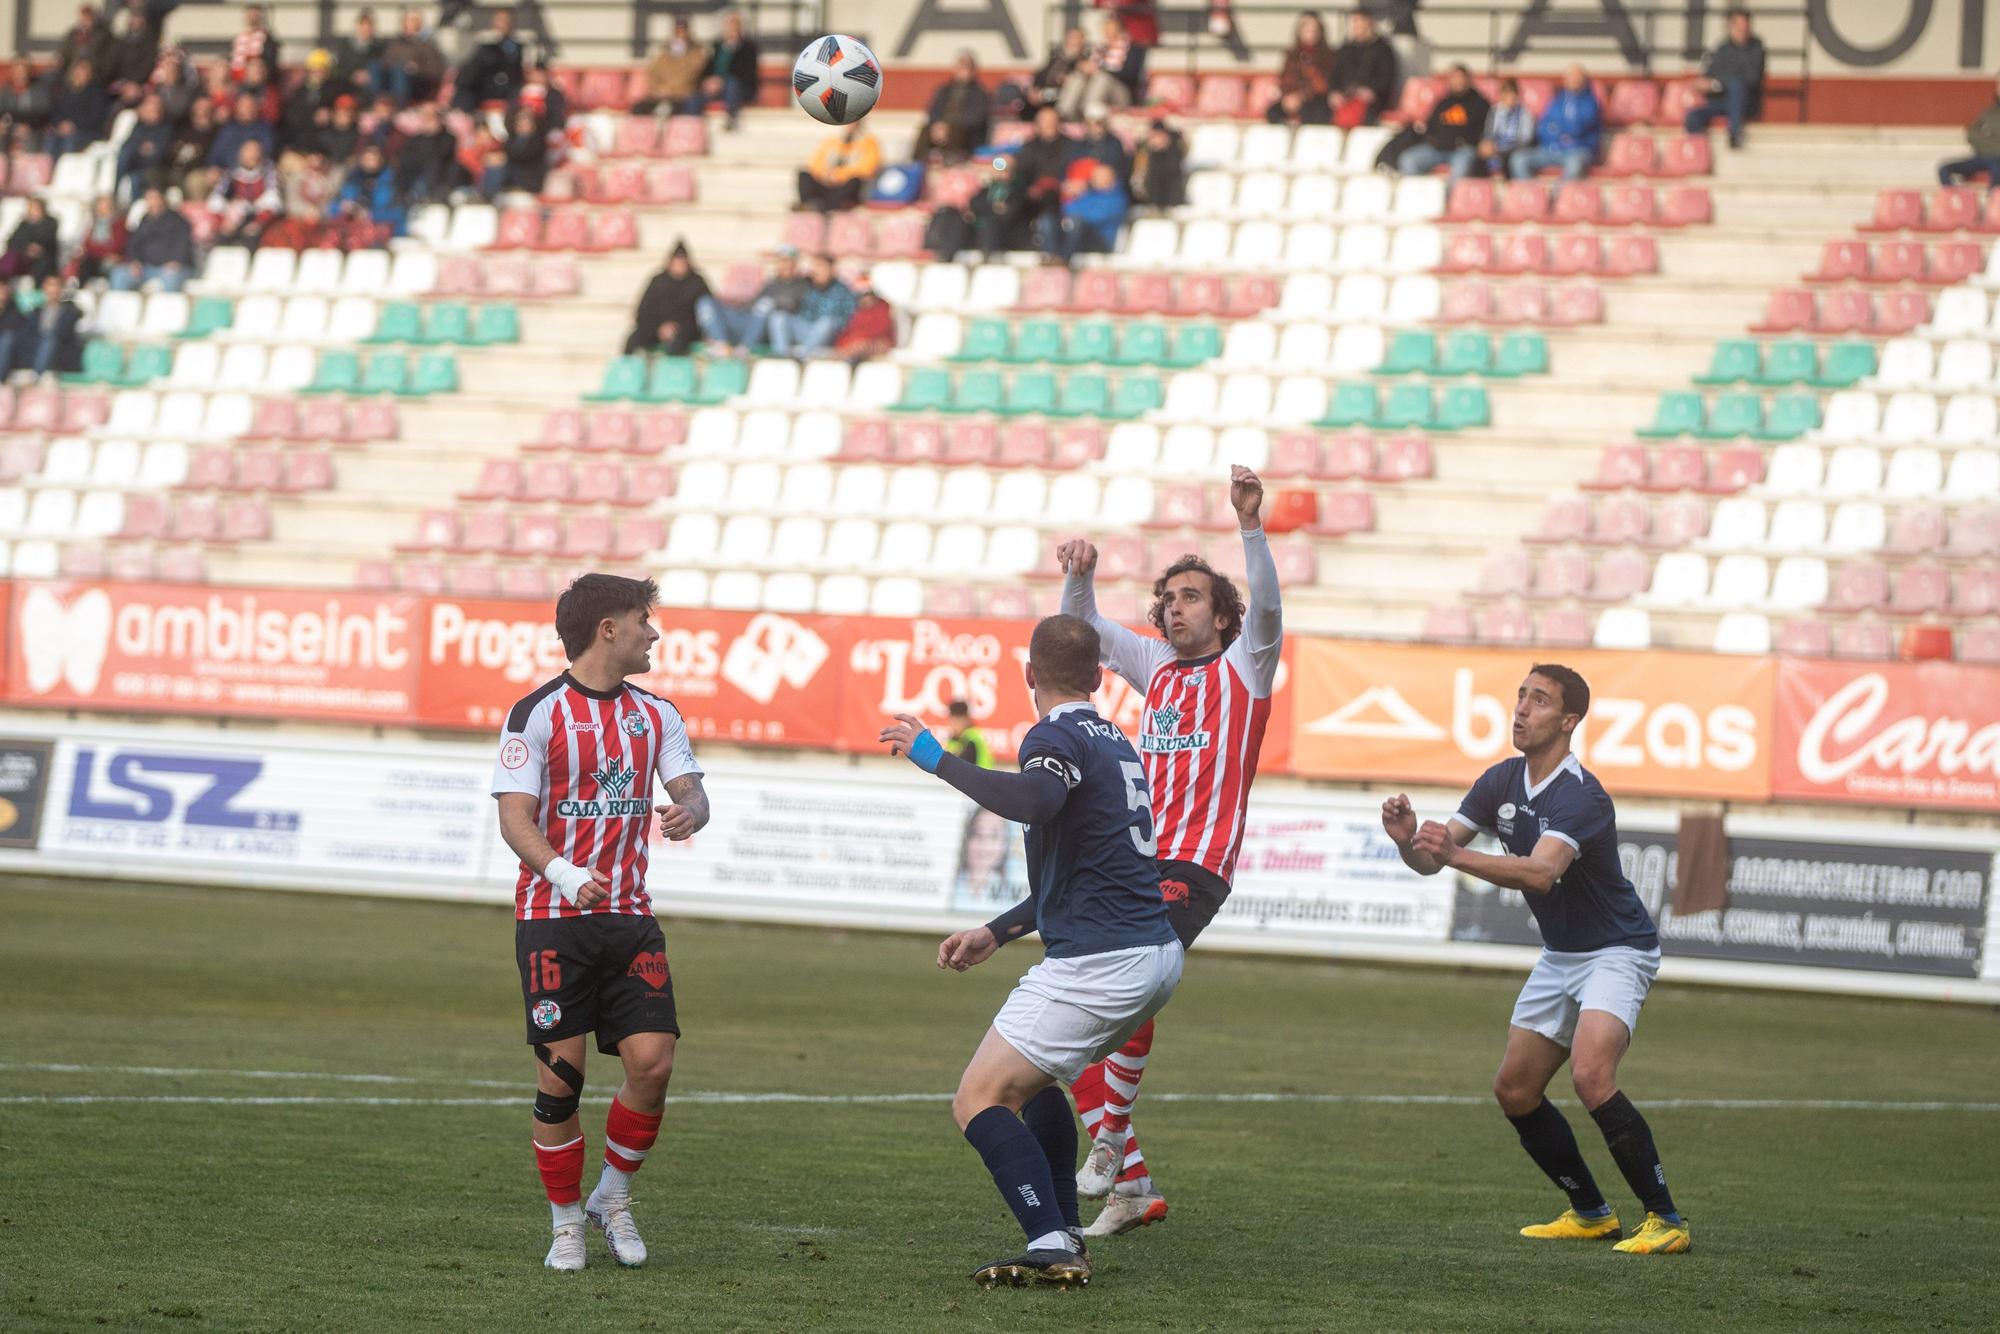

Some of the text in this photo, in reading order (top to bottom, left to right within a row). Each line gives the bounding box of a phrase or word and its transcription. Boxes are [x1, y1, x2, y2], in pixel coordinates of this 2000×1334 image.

[117, 594, 409, 668] ambiseint
[568, 722, 600, 732] uhlsport
[1043, 757, 1065, 777] C
[69, 751, 264, 828] LSZ
[558, 801, 603, 817] CAJA
[1119, 760, 1158, 857] 5
[529, 949, 562, 993] 16
